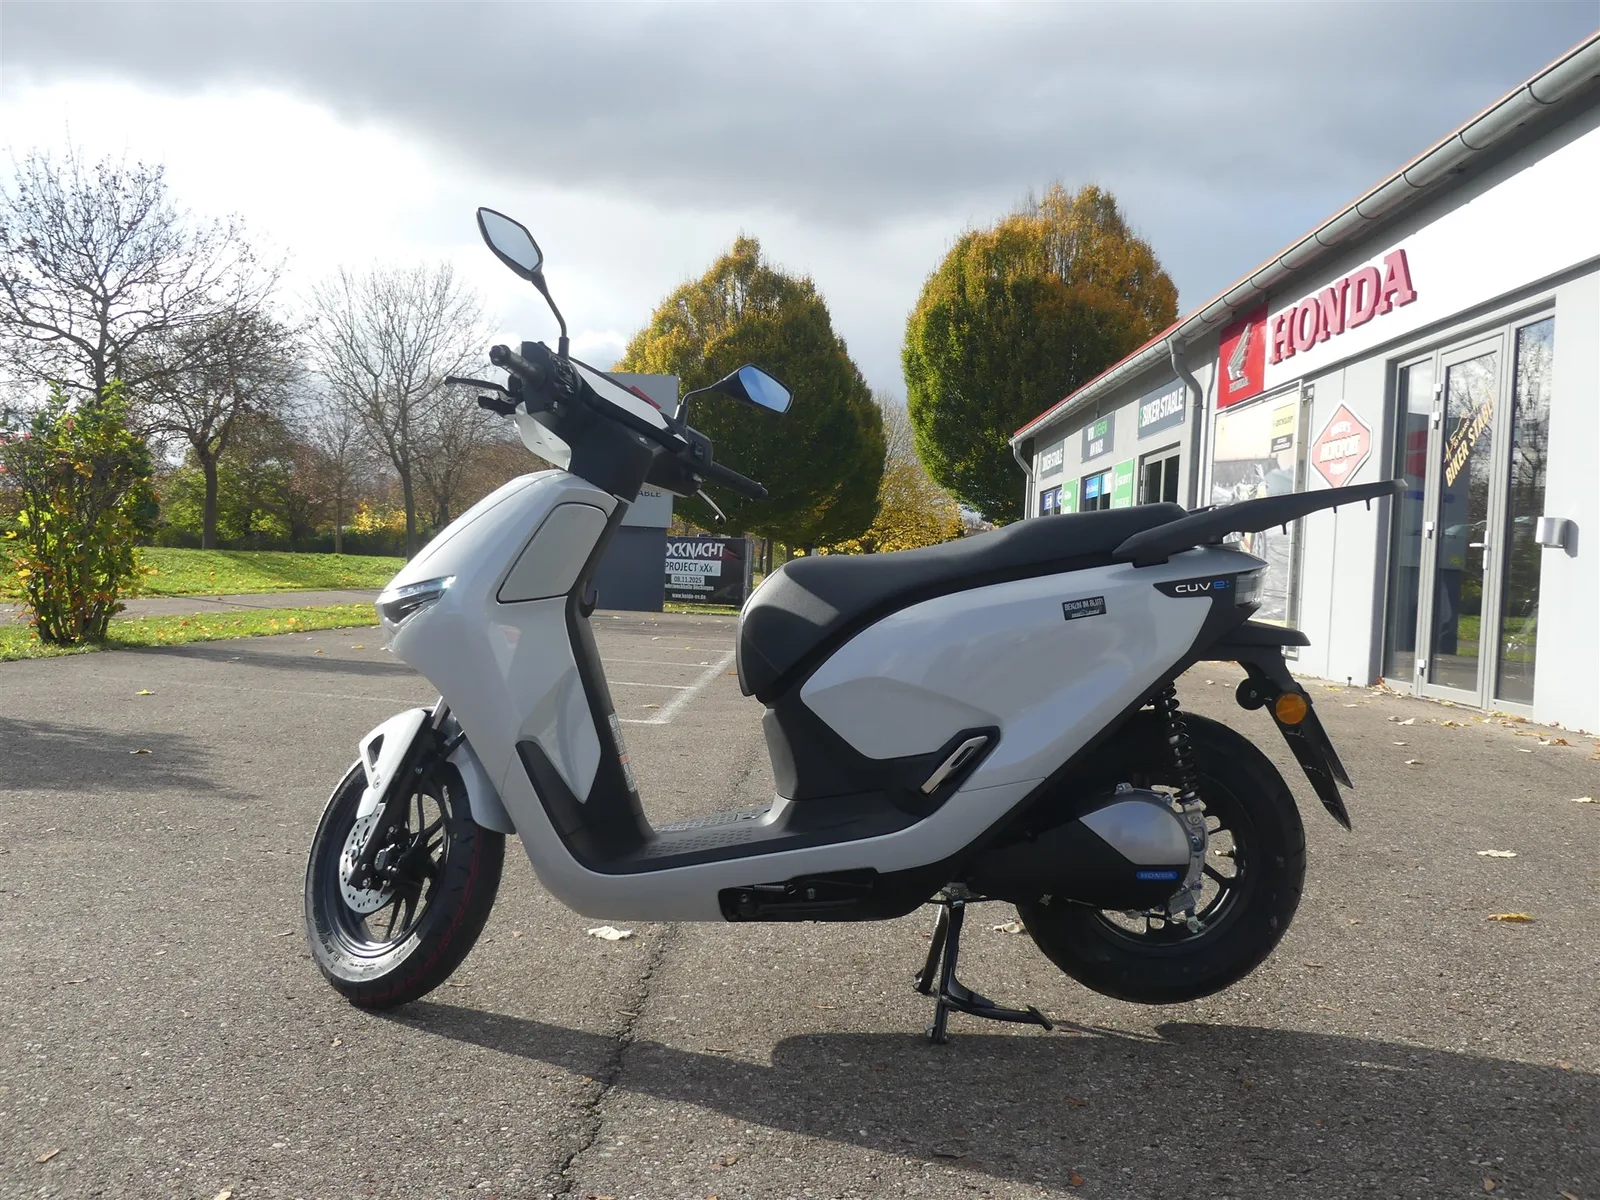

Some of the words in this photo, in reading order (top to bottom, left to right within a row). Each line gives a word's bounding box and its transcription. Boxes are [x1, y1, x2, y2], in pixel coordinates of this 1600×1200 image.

[1268, 249, 1418, 364] HONDA
[1160, 387, 1184, 418] STABLE
[1445, 440, 1469, 487] BIKER
[665, 562, 698, 572] PROJECT
